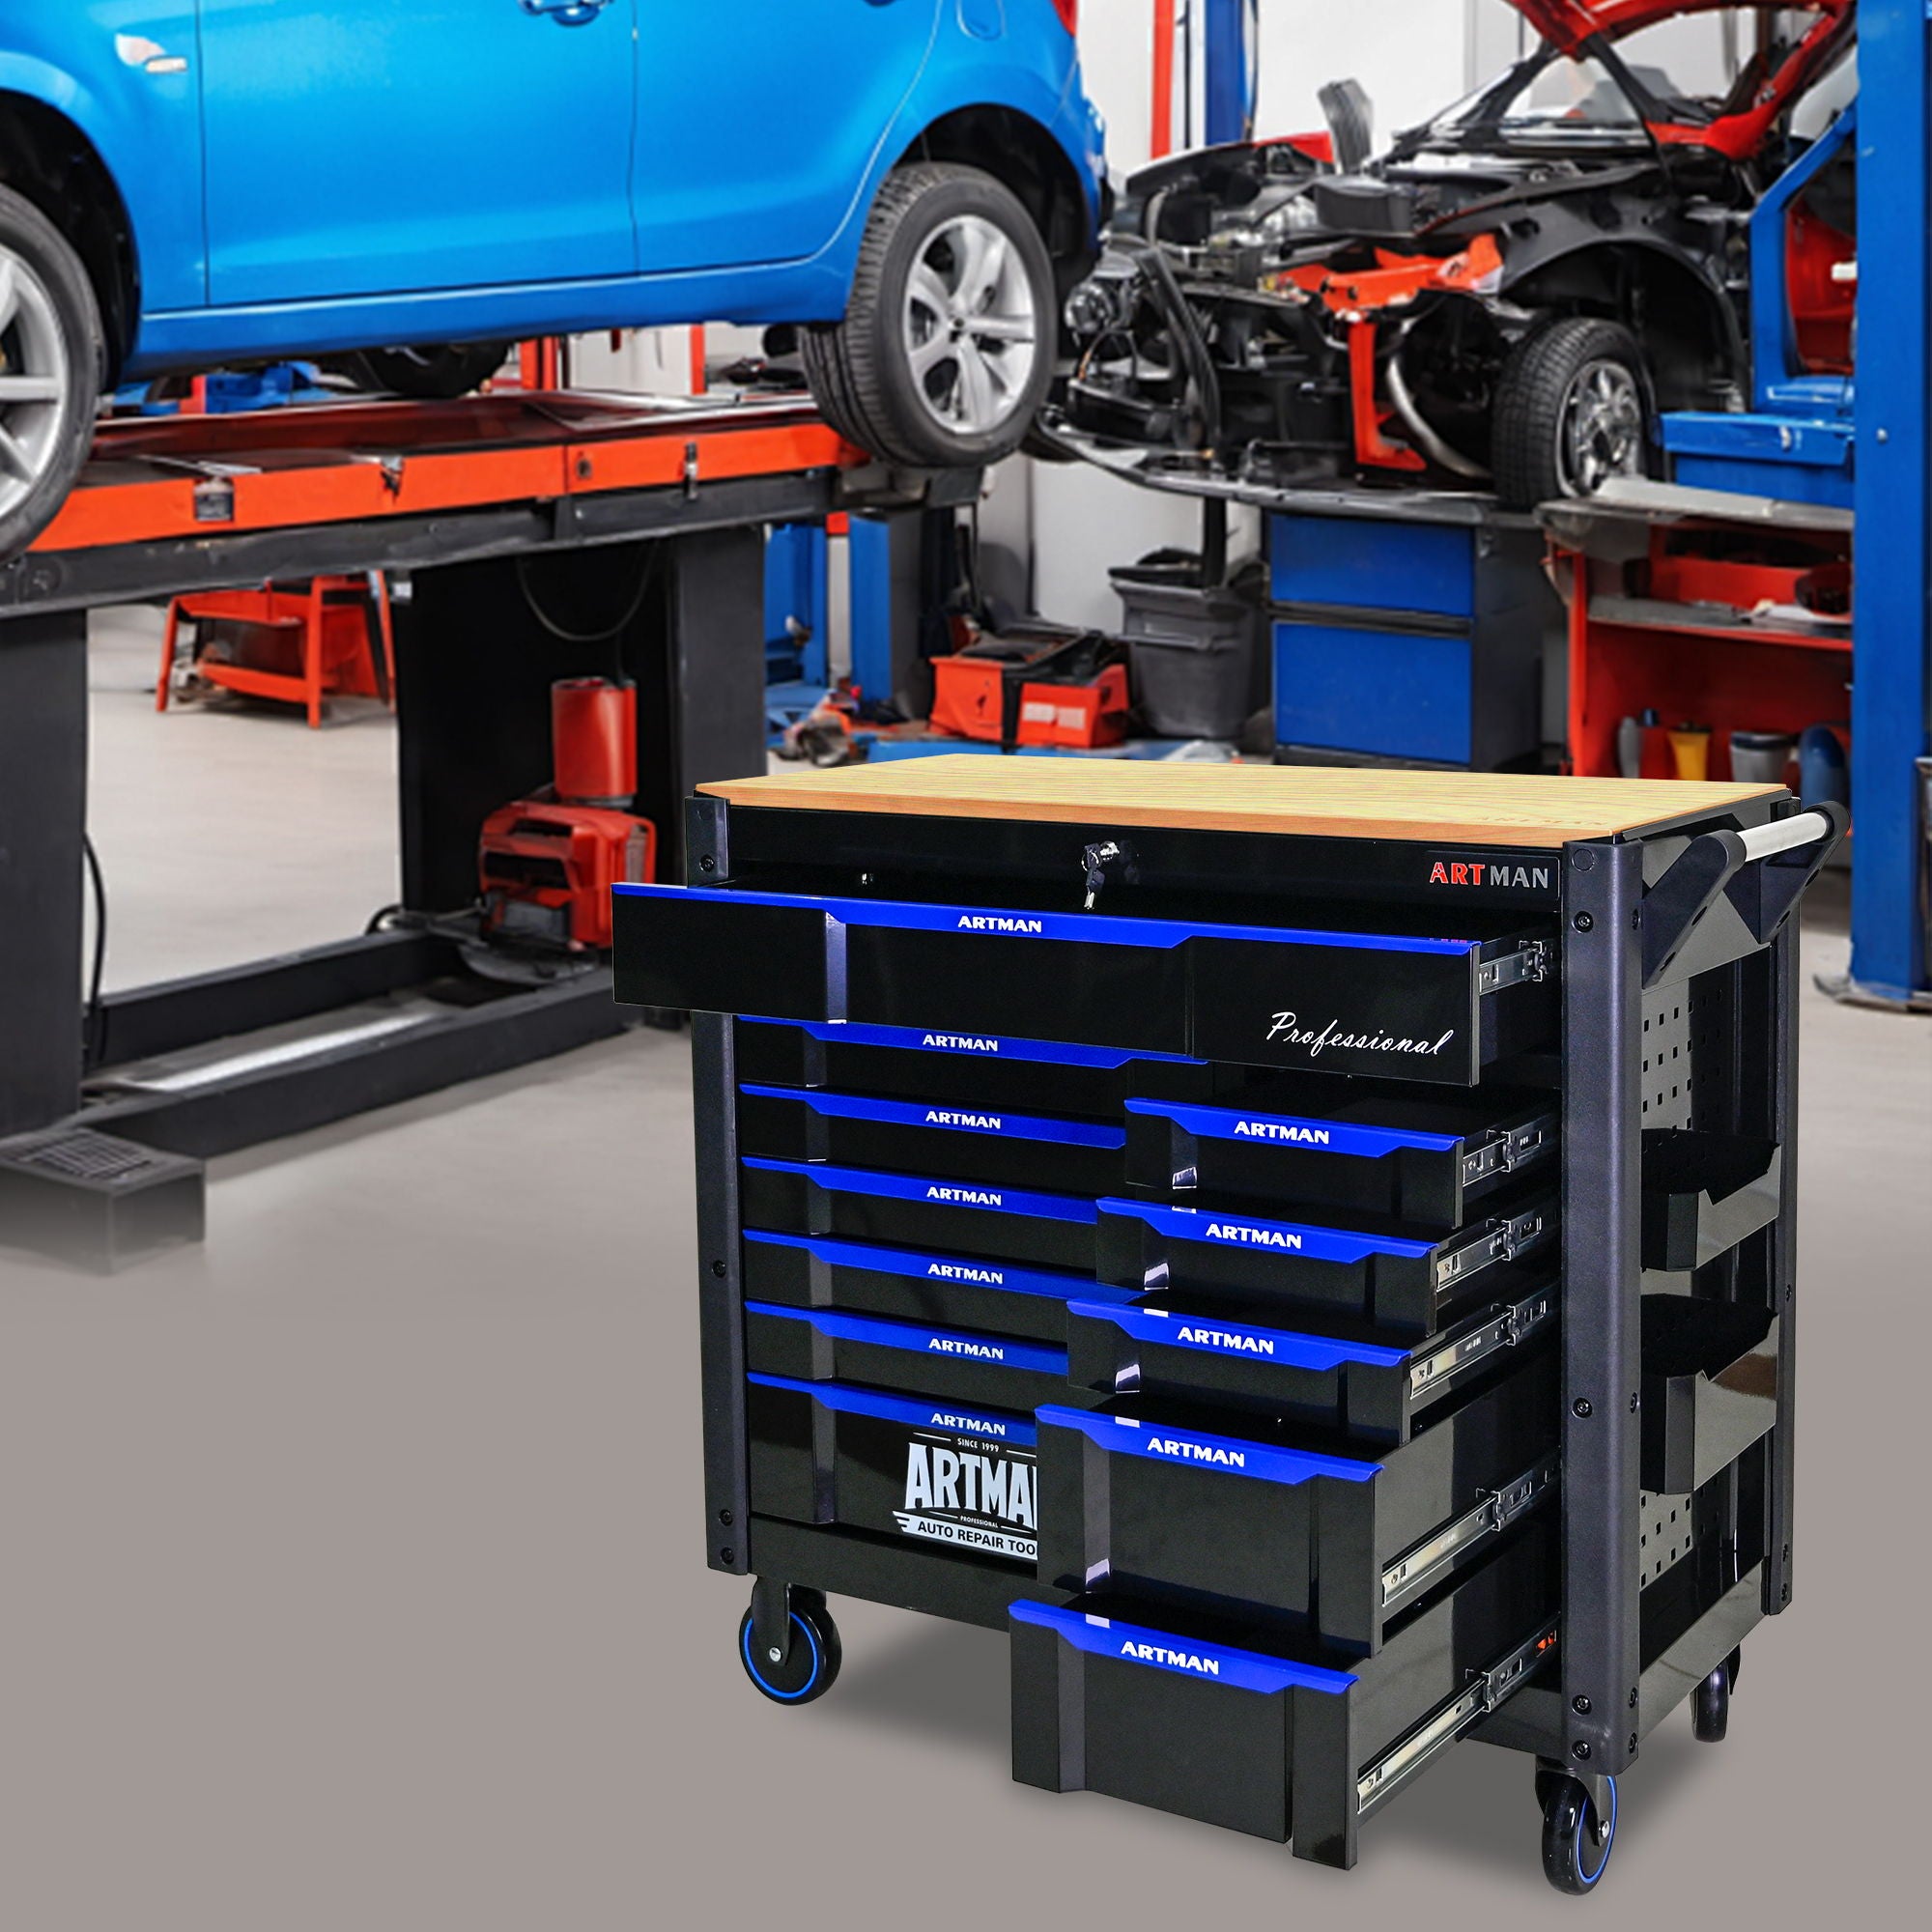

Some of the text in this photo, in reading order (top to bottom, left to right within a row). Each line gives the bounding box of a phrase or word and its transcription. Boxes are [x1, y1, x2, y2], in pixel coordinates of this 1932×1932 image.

[957, 915, 1042, 933] ARTMAN
[923, 1034, 998, 1052] ARTMAN
[1266, 1011, 1454, 1058] Professional
[925, 1110, 1001, 1129] ARTMAN
[1234, 1121, 1329, 1145] ARTMAN
[926, 1186, 1002, 1207] ARTMAN
[1205, 1223, 1302, 1249] ARTMAN
[927, 1263, 1004, 1285] ARTMAN
[928, 1338, 1004, 1360] ARTMAN
[1177, 1326, 1274, 1355] ARTMAN
[930, 1412, 1006, 1436] ARTMAN
[957, 1437, 1000, 1453] SINCE 1999
[1147, 1436, 1245, 1467] ARTMAN
[904, 1442, 1038, 1530] ARTMA
[960, 1515, 999, 1529] PROFESSIONAL
[918, 1520, 1037, 1555] AUTO REPAIR TOO
[1121, 1640, 1219, 1675] ARTMAN
